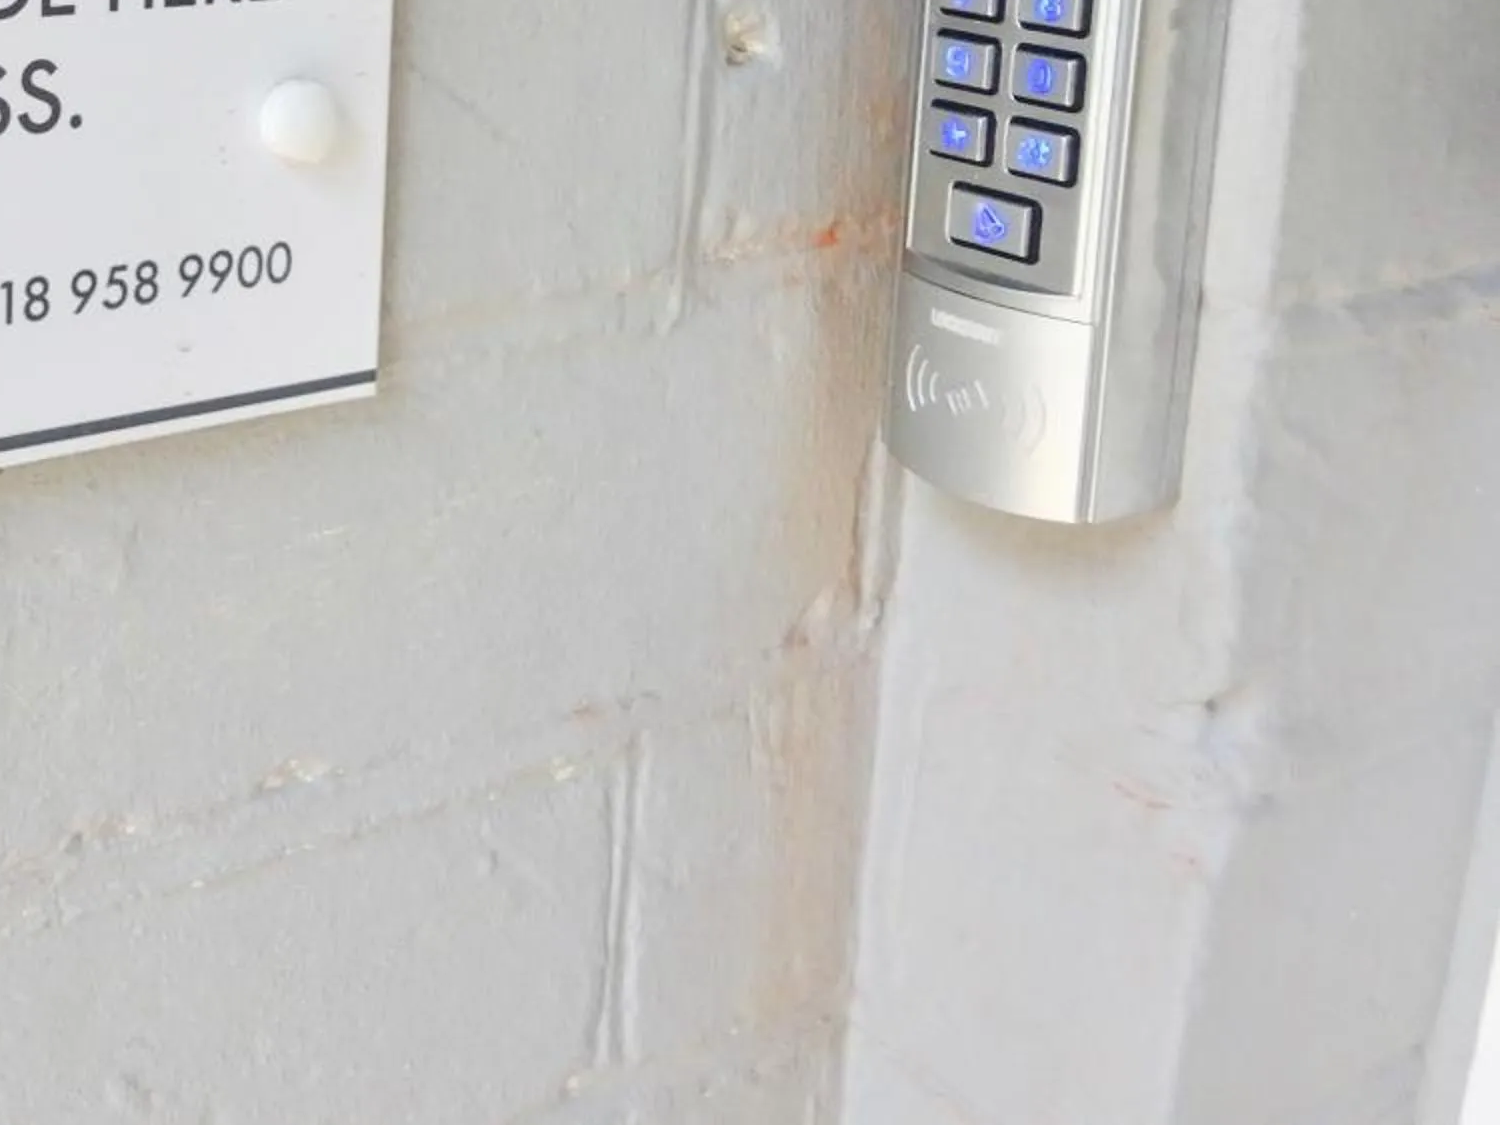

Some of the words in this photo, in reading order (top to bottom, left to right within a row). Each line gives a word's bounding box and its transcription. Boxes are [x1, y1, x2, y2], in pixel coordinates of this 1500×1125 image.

[946, 46, 972, 79] 9
[69, 259, 160, 316] 958
[177, 240, 293, 299] 9900
